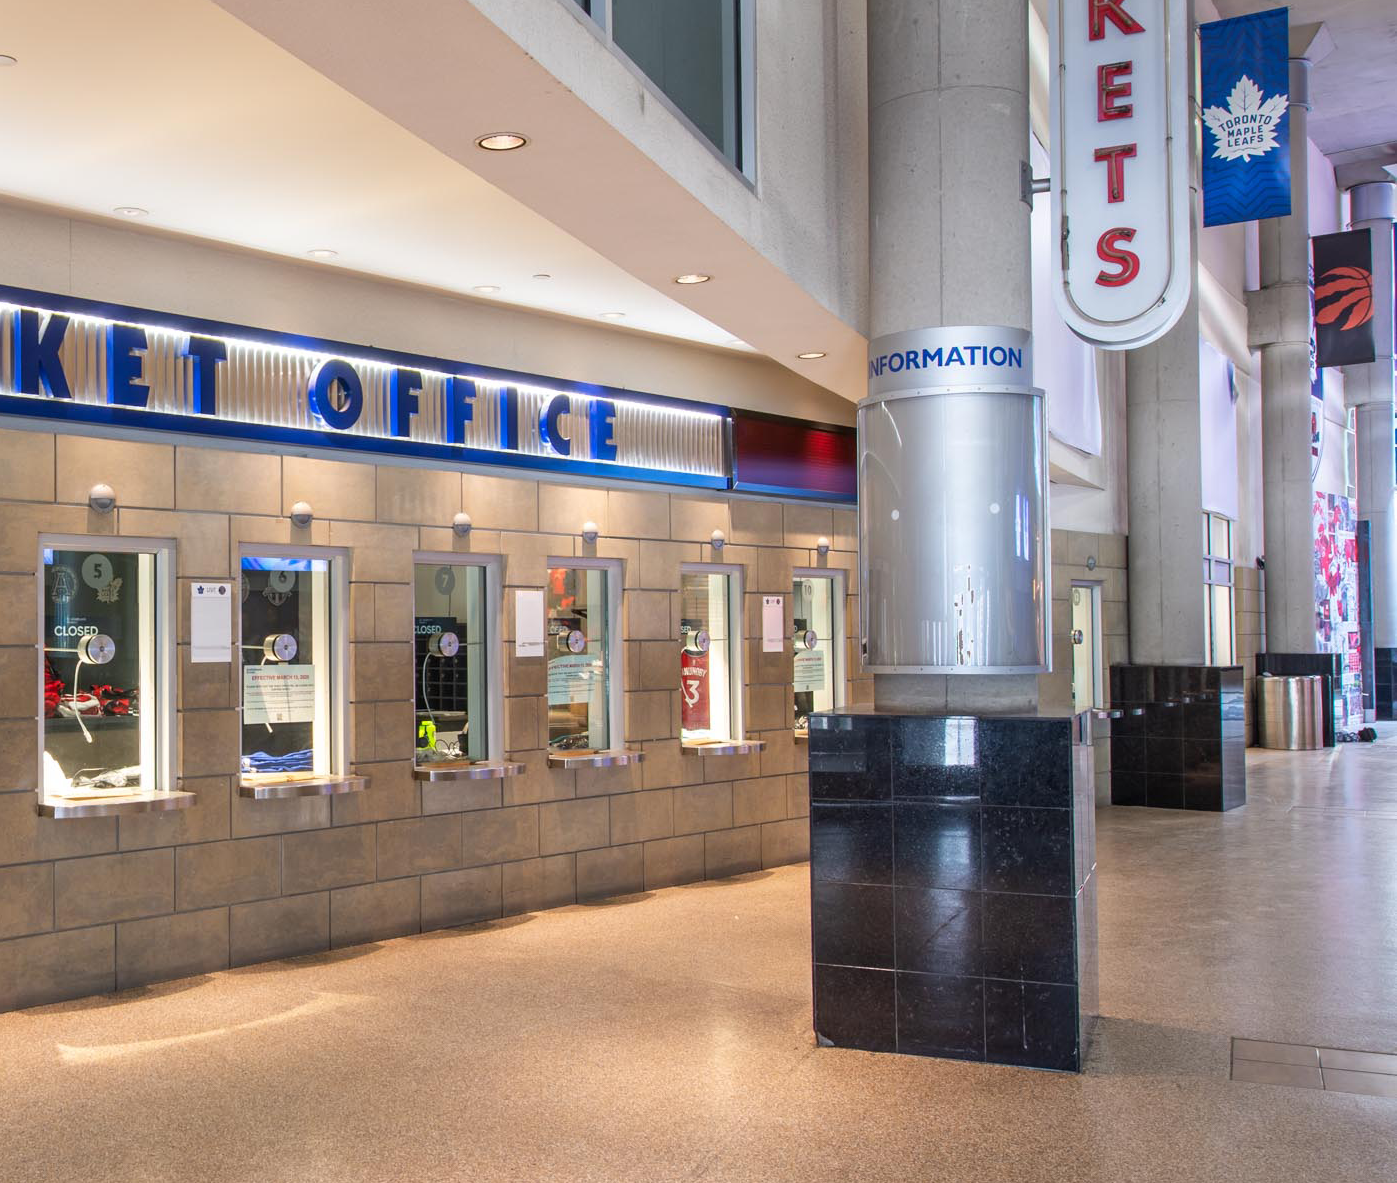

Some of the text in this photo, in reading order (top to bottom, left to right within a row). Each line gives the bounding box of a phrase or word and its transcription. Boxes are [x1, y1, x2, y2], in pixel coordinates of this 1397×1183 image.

[1218, 114, 1273, 132] TORONTO
[1227, 125, 1264, 138] MAPLE
[1227, 134, 1264, 148] LEAFS
[308, 358, 618, 461] OFFICE
[93, 563, 103, 579] 5
[54, 625, 99, 637] CLOSED
[686, 679, 700, 705] 3
